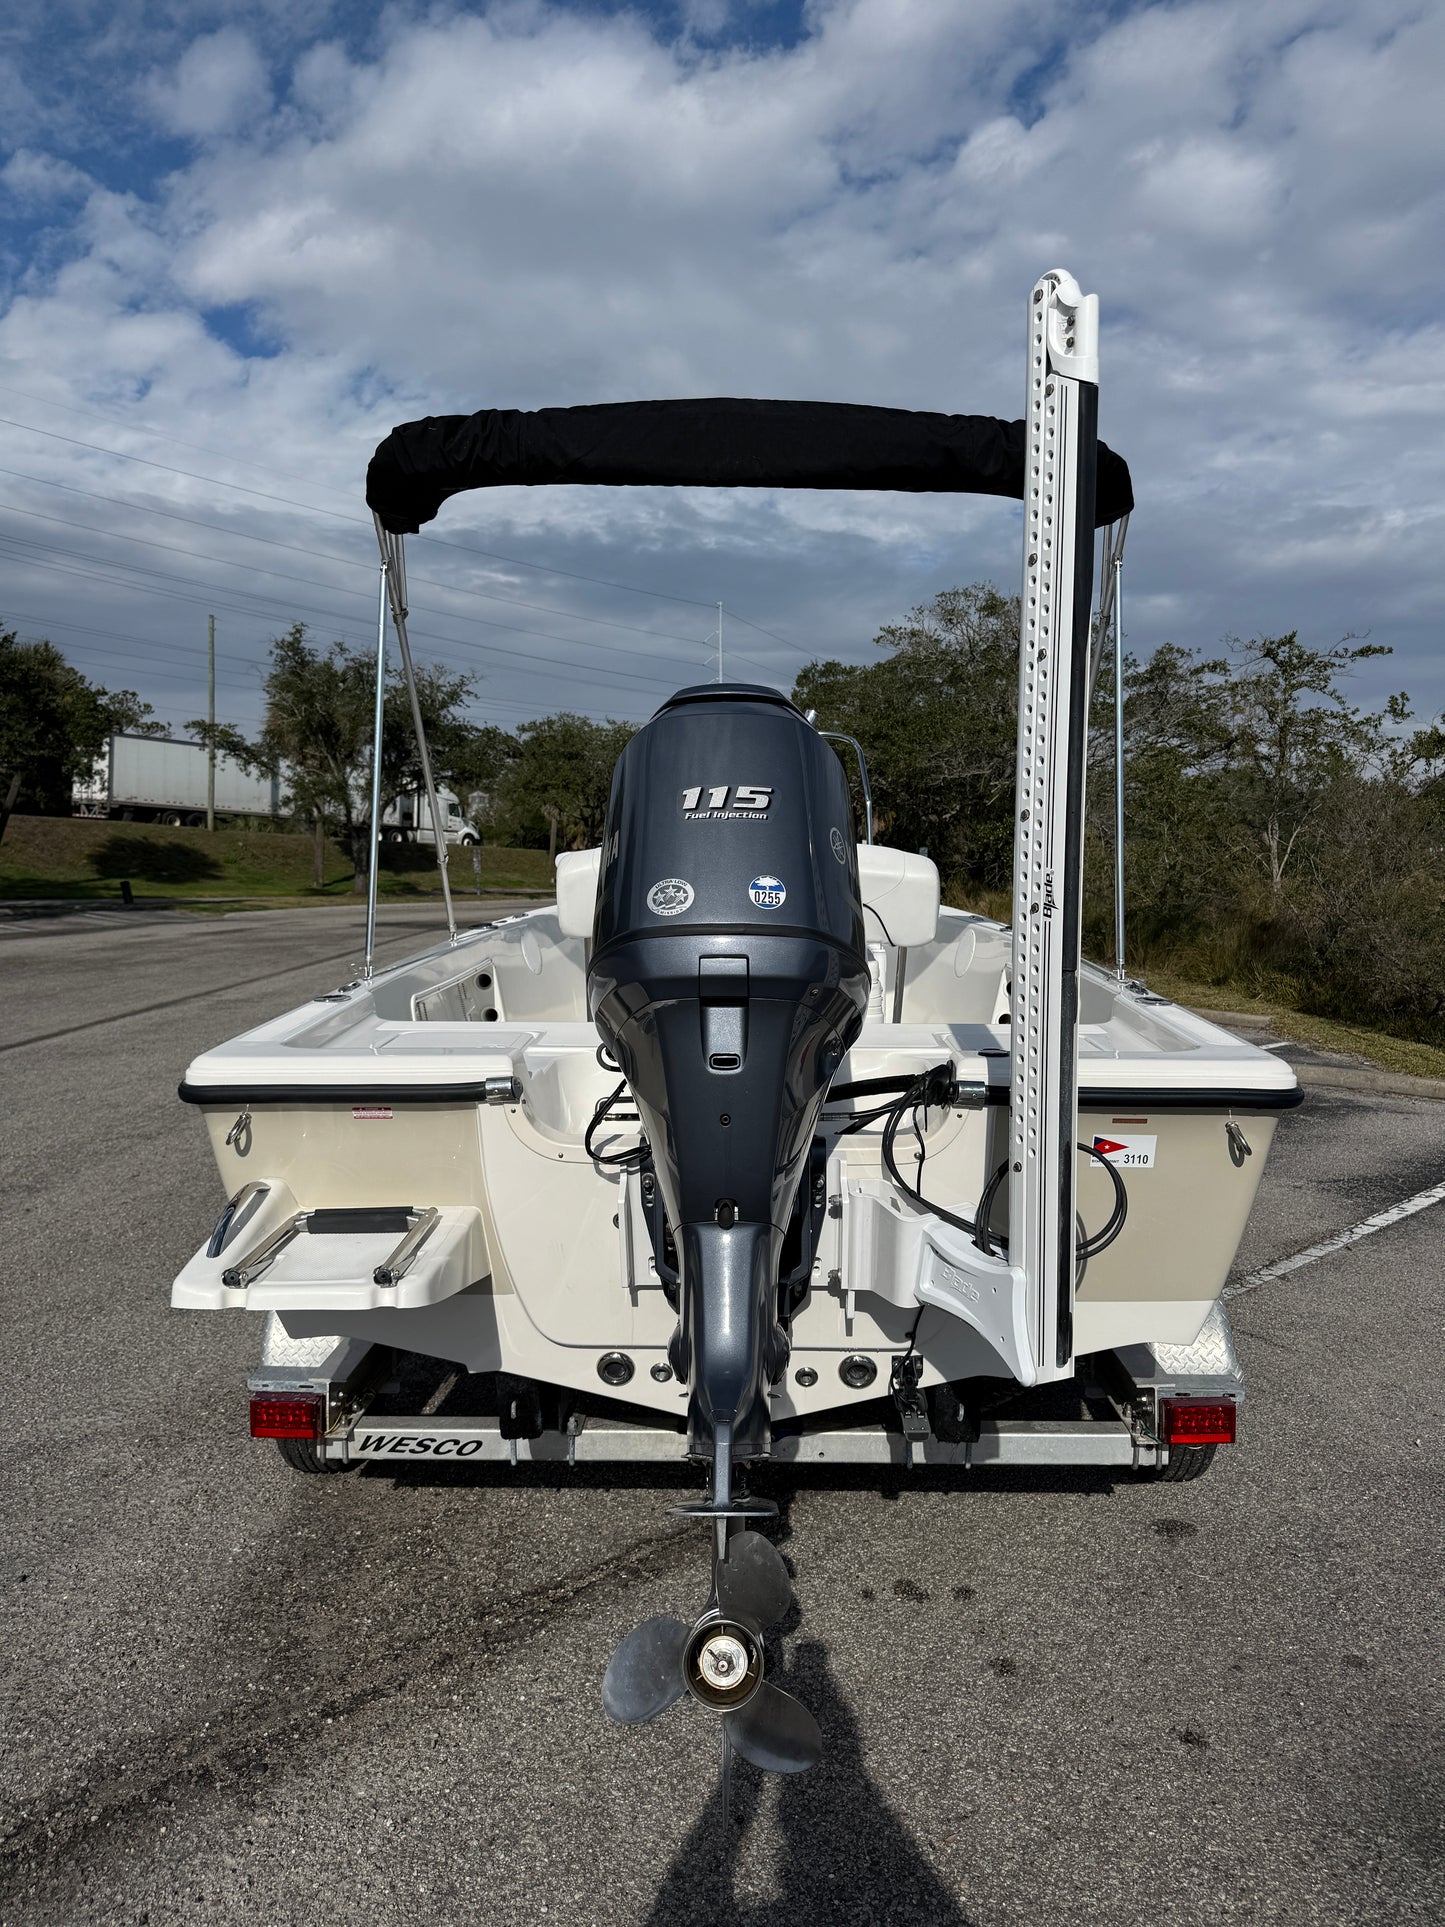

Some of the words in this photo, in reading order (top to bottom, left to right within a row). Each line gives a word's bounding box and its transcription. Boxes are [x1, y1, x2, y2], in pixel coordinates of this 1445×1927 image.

[682, 785, 773, 810] 115
[684, 811, 711, 820] Fuel
[713, 811, 768, 820] Injection
[754, 890, 781, 905] 0255
[1123, 1153, 1149, 1165] 3110
[358, 1434, 483, 1457] WESCO
